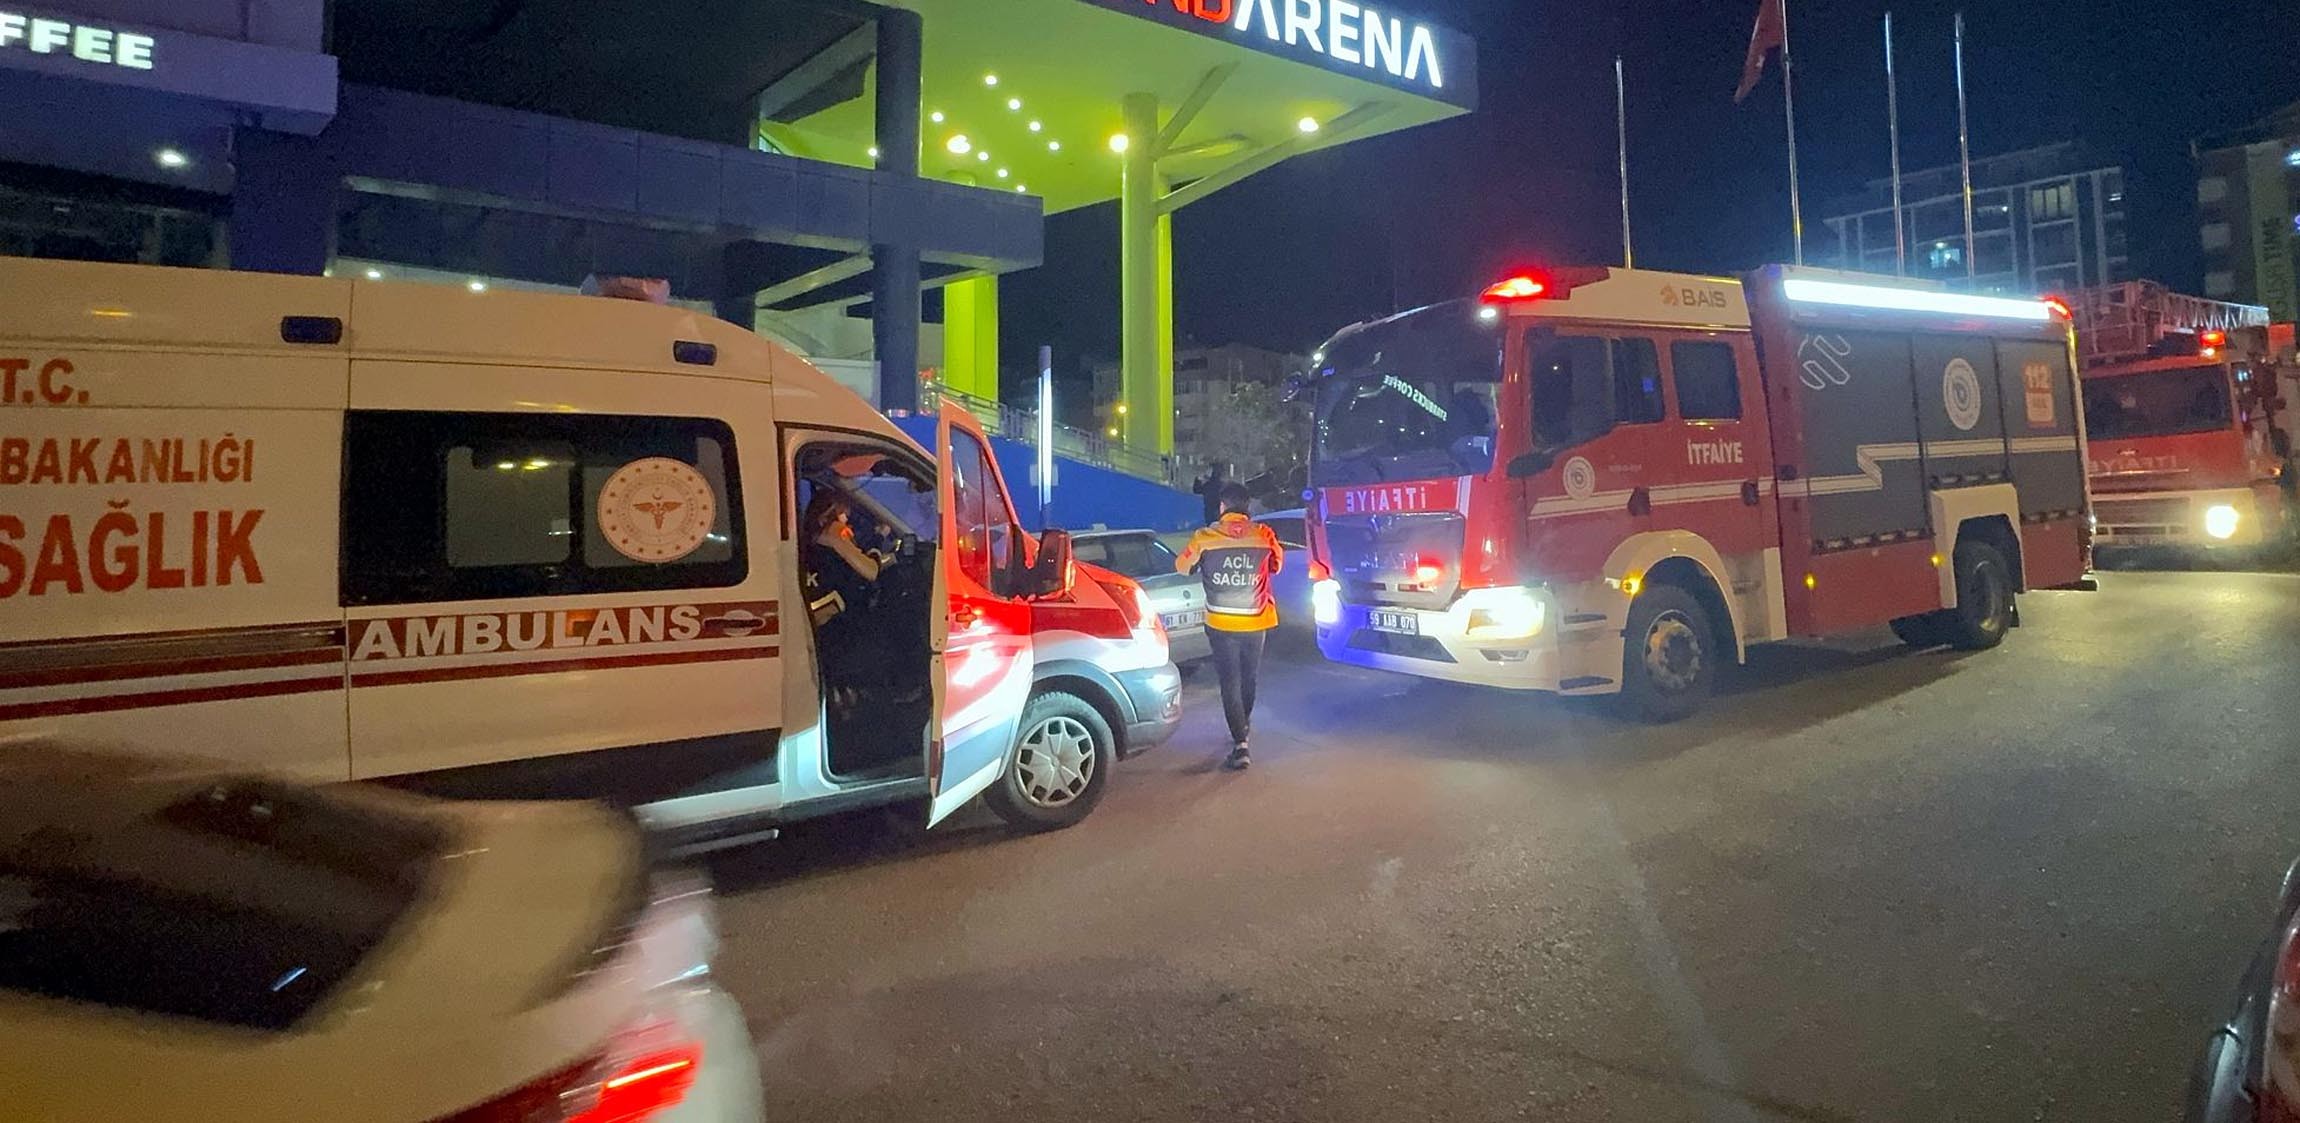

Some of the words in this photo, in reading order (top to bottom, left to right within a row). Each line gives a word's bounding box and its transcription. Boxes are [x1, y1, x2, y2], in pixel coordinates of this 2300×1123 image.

[1145, 0, 1443, 87] ARENA
[0, 359, 90, 404] T.C.
[1, 433, 254, 484] BAKANLIĞI
[1687, 438, 1743, 465] İTFAİYE
[0, 500, 265, 598] SAĞLIK
[1223, 553, 1254, 569] ACİL
[351, 605, 700, 661] AMBULANS
